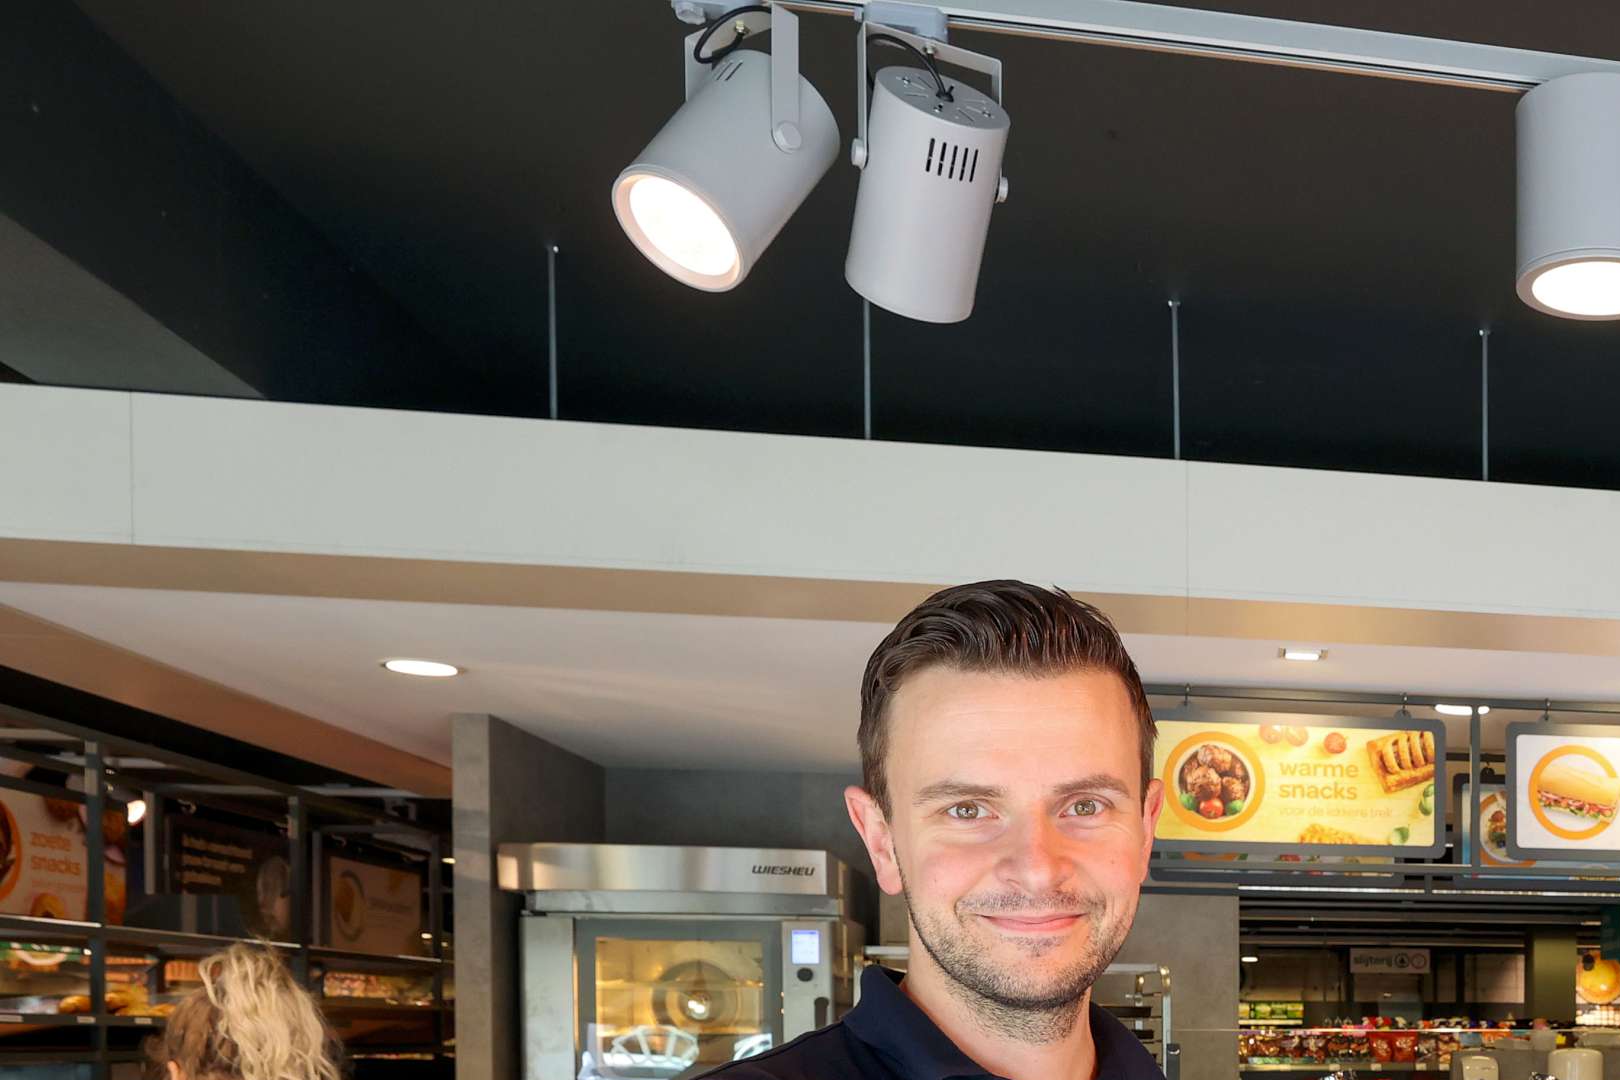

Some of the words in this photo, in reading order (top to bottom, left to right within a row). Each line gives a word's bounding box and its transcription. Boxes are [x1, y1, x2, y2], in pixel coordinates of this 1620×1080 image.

[1279, 762, 1359, 778] warme
[1279, 782, 1358, 800] snacks
[31, 855, 81, 877] snacks
[752, 865, 815, 877] WIESHEU
